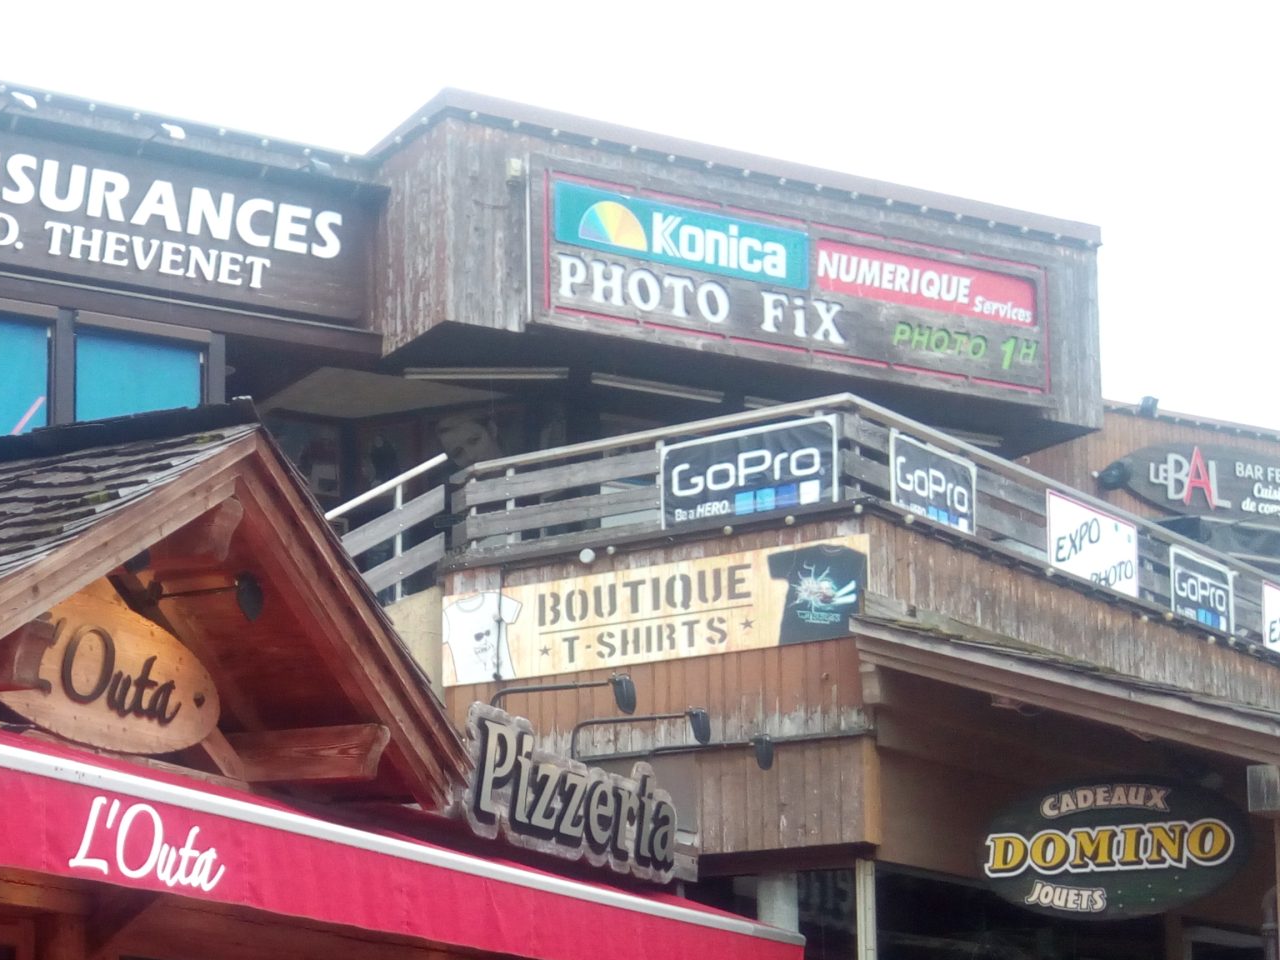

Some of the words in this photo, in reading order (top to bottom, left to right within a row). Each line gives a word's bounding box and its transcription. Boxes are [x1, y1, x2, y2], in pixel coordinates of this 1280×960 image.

[43, 219, 271, 289] THEVENET
[651, 210, 787, 279] Konica
[556, 253, 731, 325] PHOTO
[818, 249, 971, 305] NUMERIQUE
[973, 295, 1034, 324] Services
[891, 320, 989, 362] PHOTO
[671, 446, 821, 498] GoPro
[896, 455, 968, 514] GoPro
[1149, 461, 1168, 485] LE
[1166, 445, 1232, 511] BAL
[1235, 461, 1264, 481] BAR
[675, 508, 688, 522] Be
[1241, 497, 1257, 513] de
[1055, 517, 1101, 563] EXPO
[537, 563, 753, 627] BOUTIQUE
[1175, 567, 1226, 613] GoPro
[561, 616, 728, 664] T-SHIRTS
[477, 719, 675, 868] Pizzeria
[1041, 784, 1170, 819] CADEAUX
[68, 795, 227, 892] L'Outa
[986, 819, 1233, 876] DOMINO
[1026, 880, 1106, 912] JOUETS
